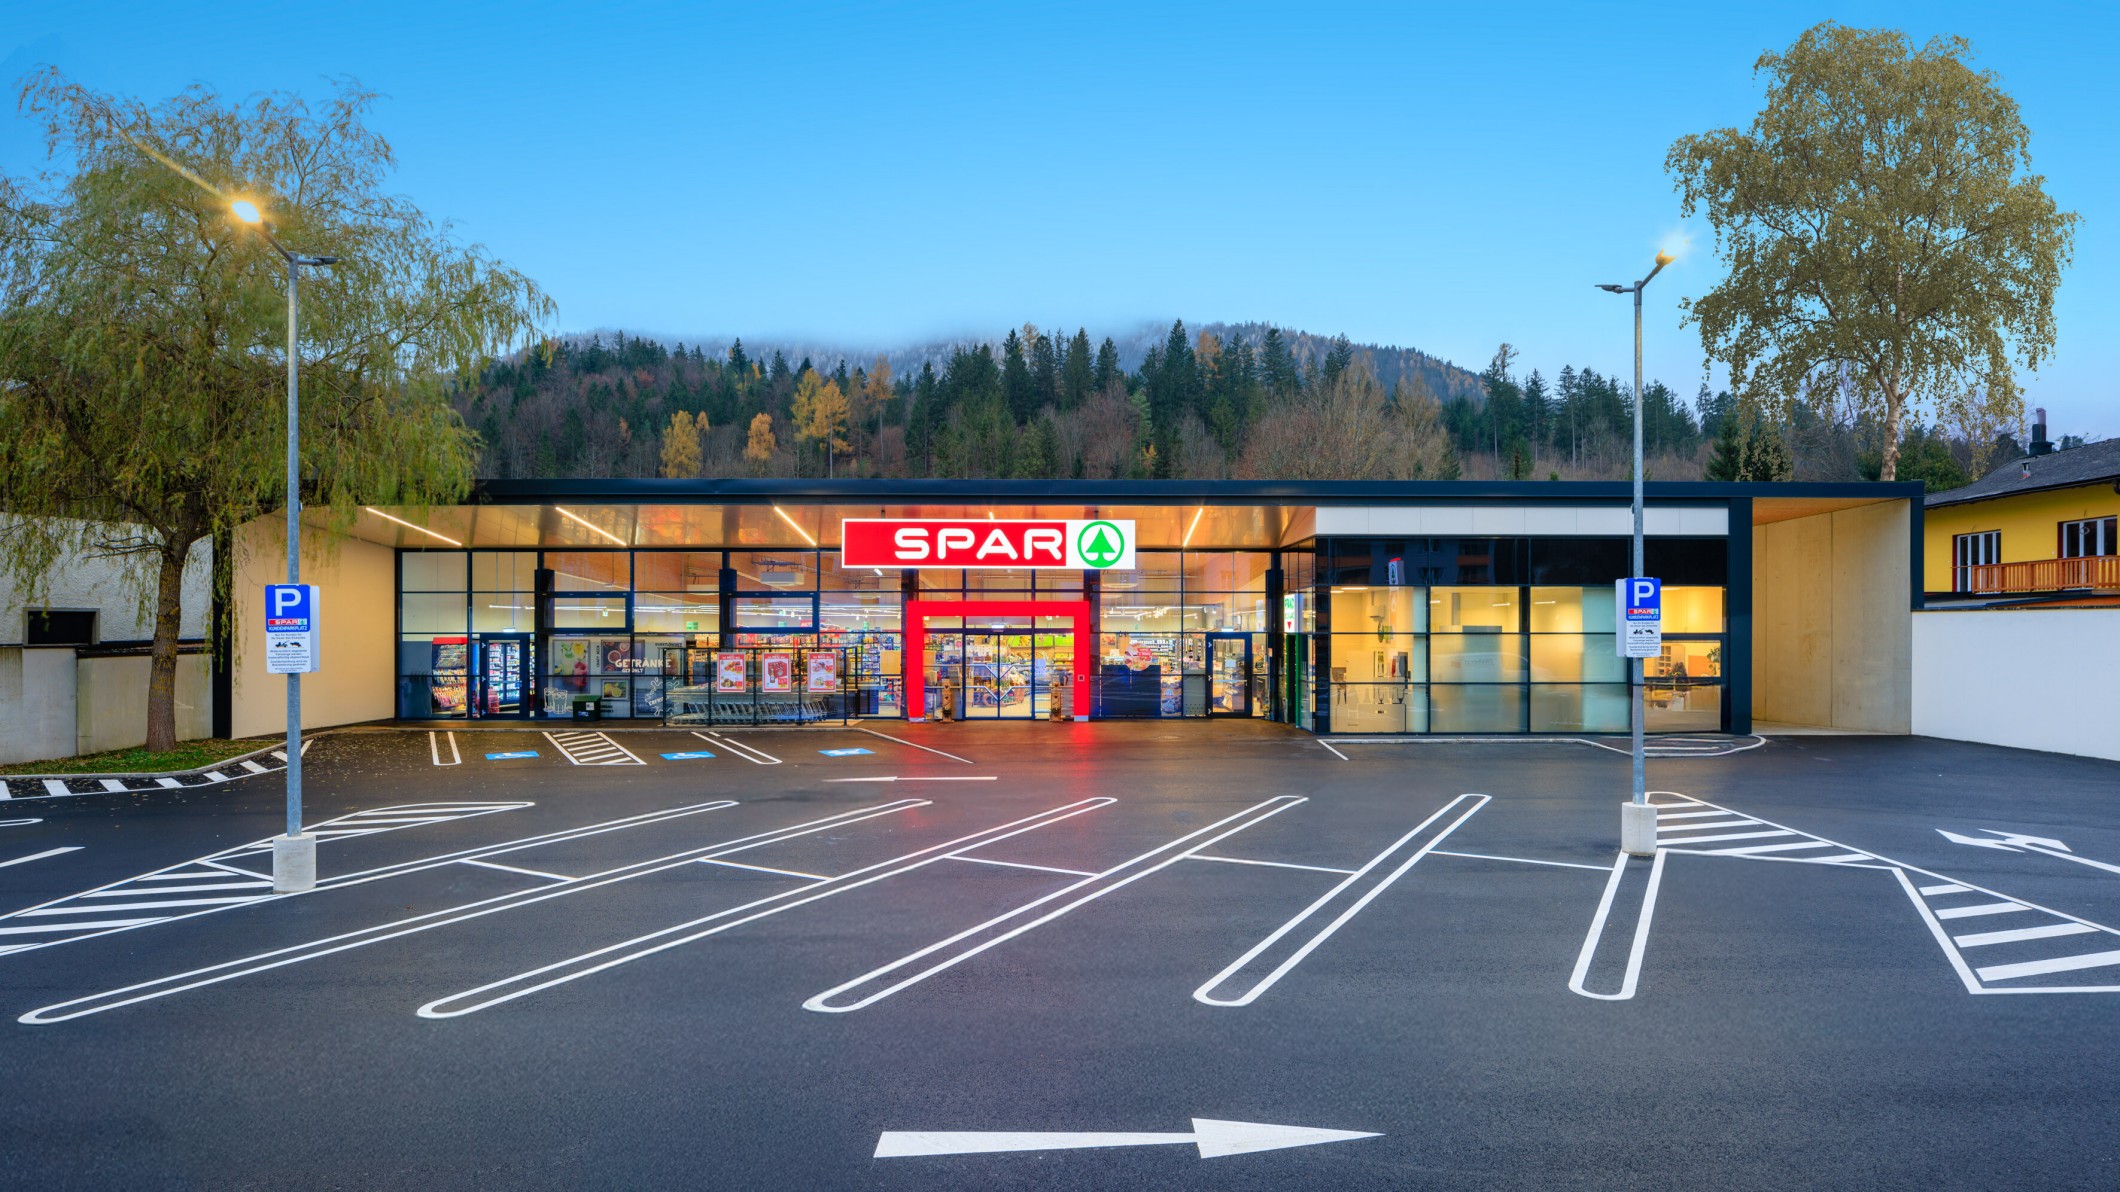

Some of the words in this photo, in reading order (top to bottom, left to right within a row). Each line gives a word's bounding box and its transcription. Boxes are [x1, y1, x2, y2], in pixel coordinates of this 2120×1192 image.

[895, 527, 1063, 561] SPAR
[275, 588, 301, 616] P
[1634, 582, 1654, 606] P
